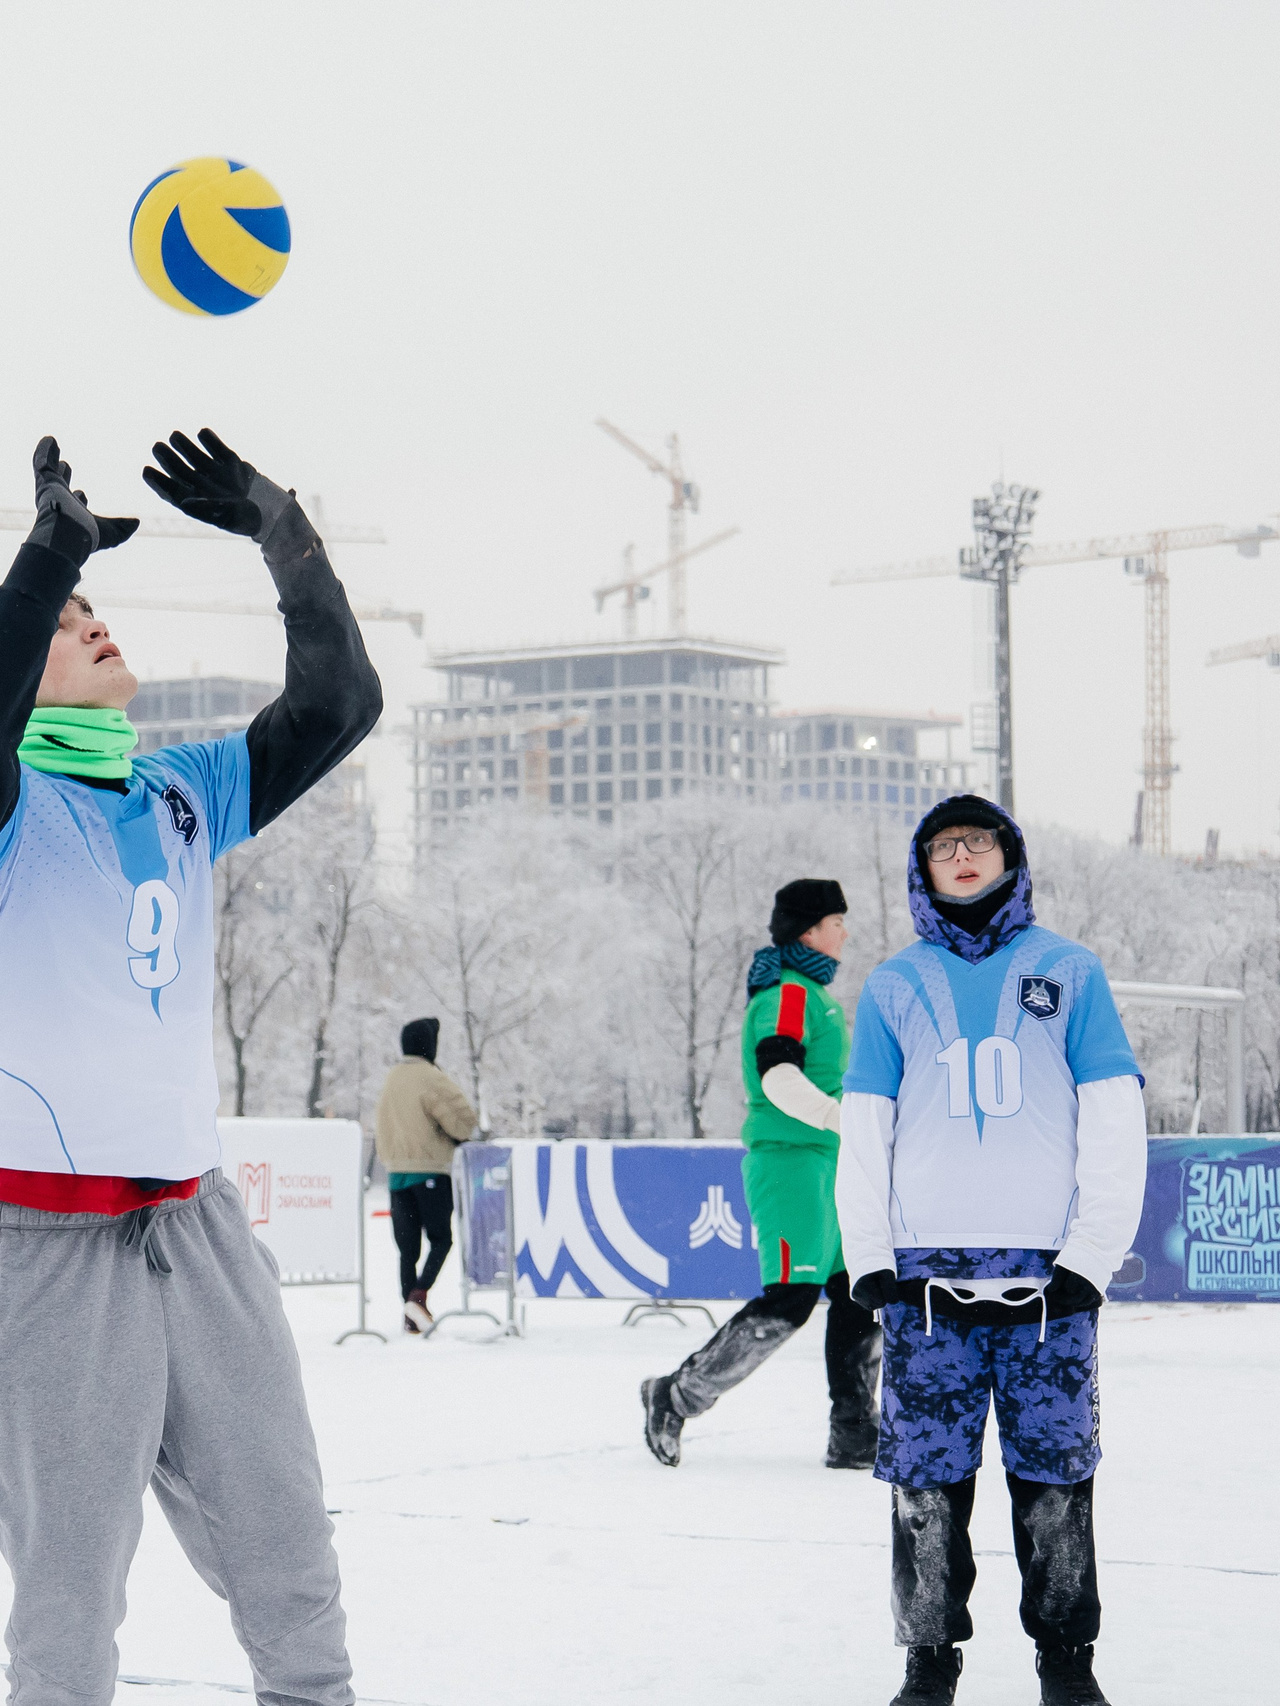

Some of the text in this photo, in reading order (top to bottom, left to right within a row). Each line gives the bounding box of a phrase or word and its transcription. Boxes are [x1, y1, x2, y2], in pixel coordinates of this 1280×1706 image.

[126, 878, 181, 990] 9
[935, 1034, 1024, 1119] 10
[1187, 1163, 1280, 1216] ЗИМН
